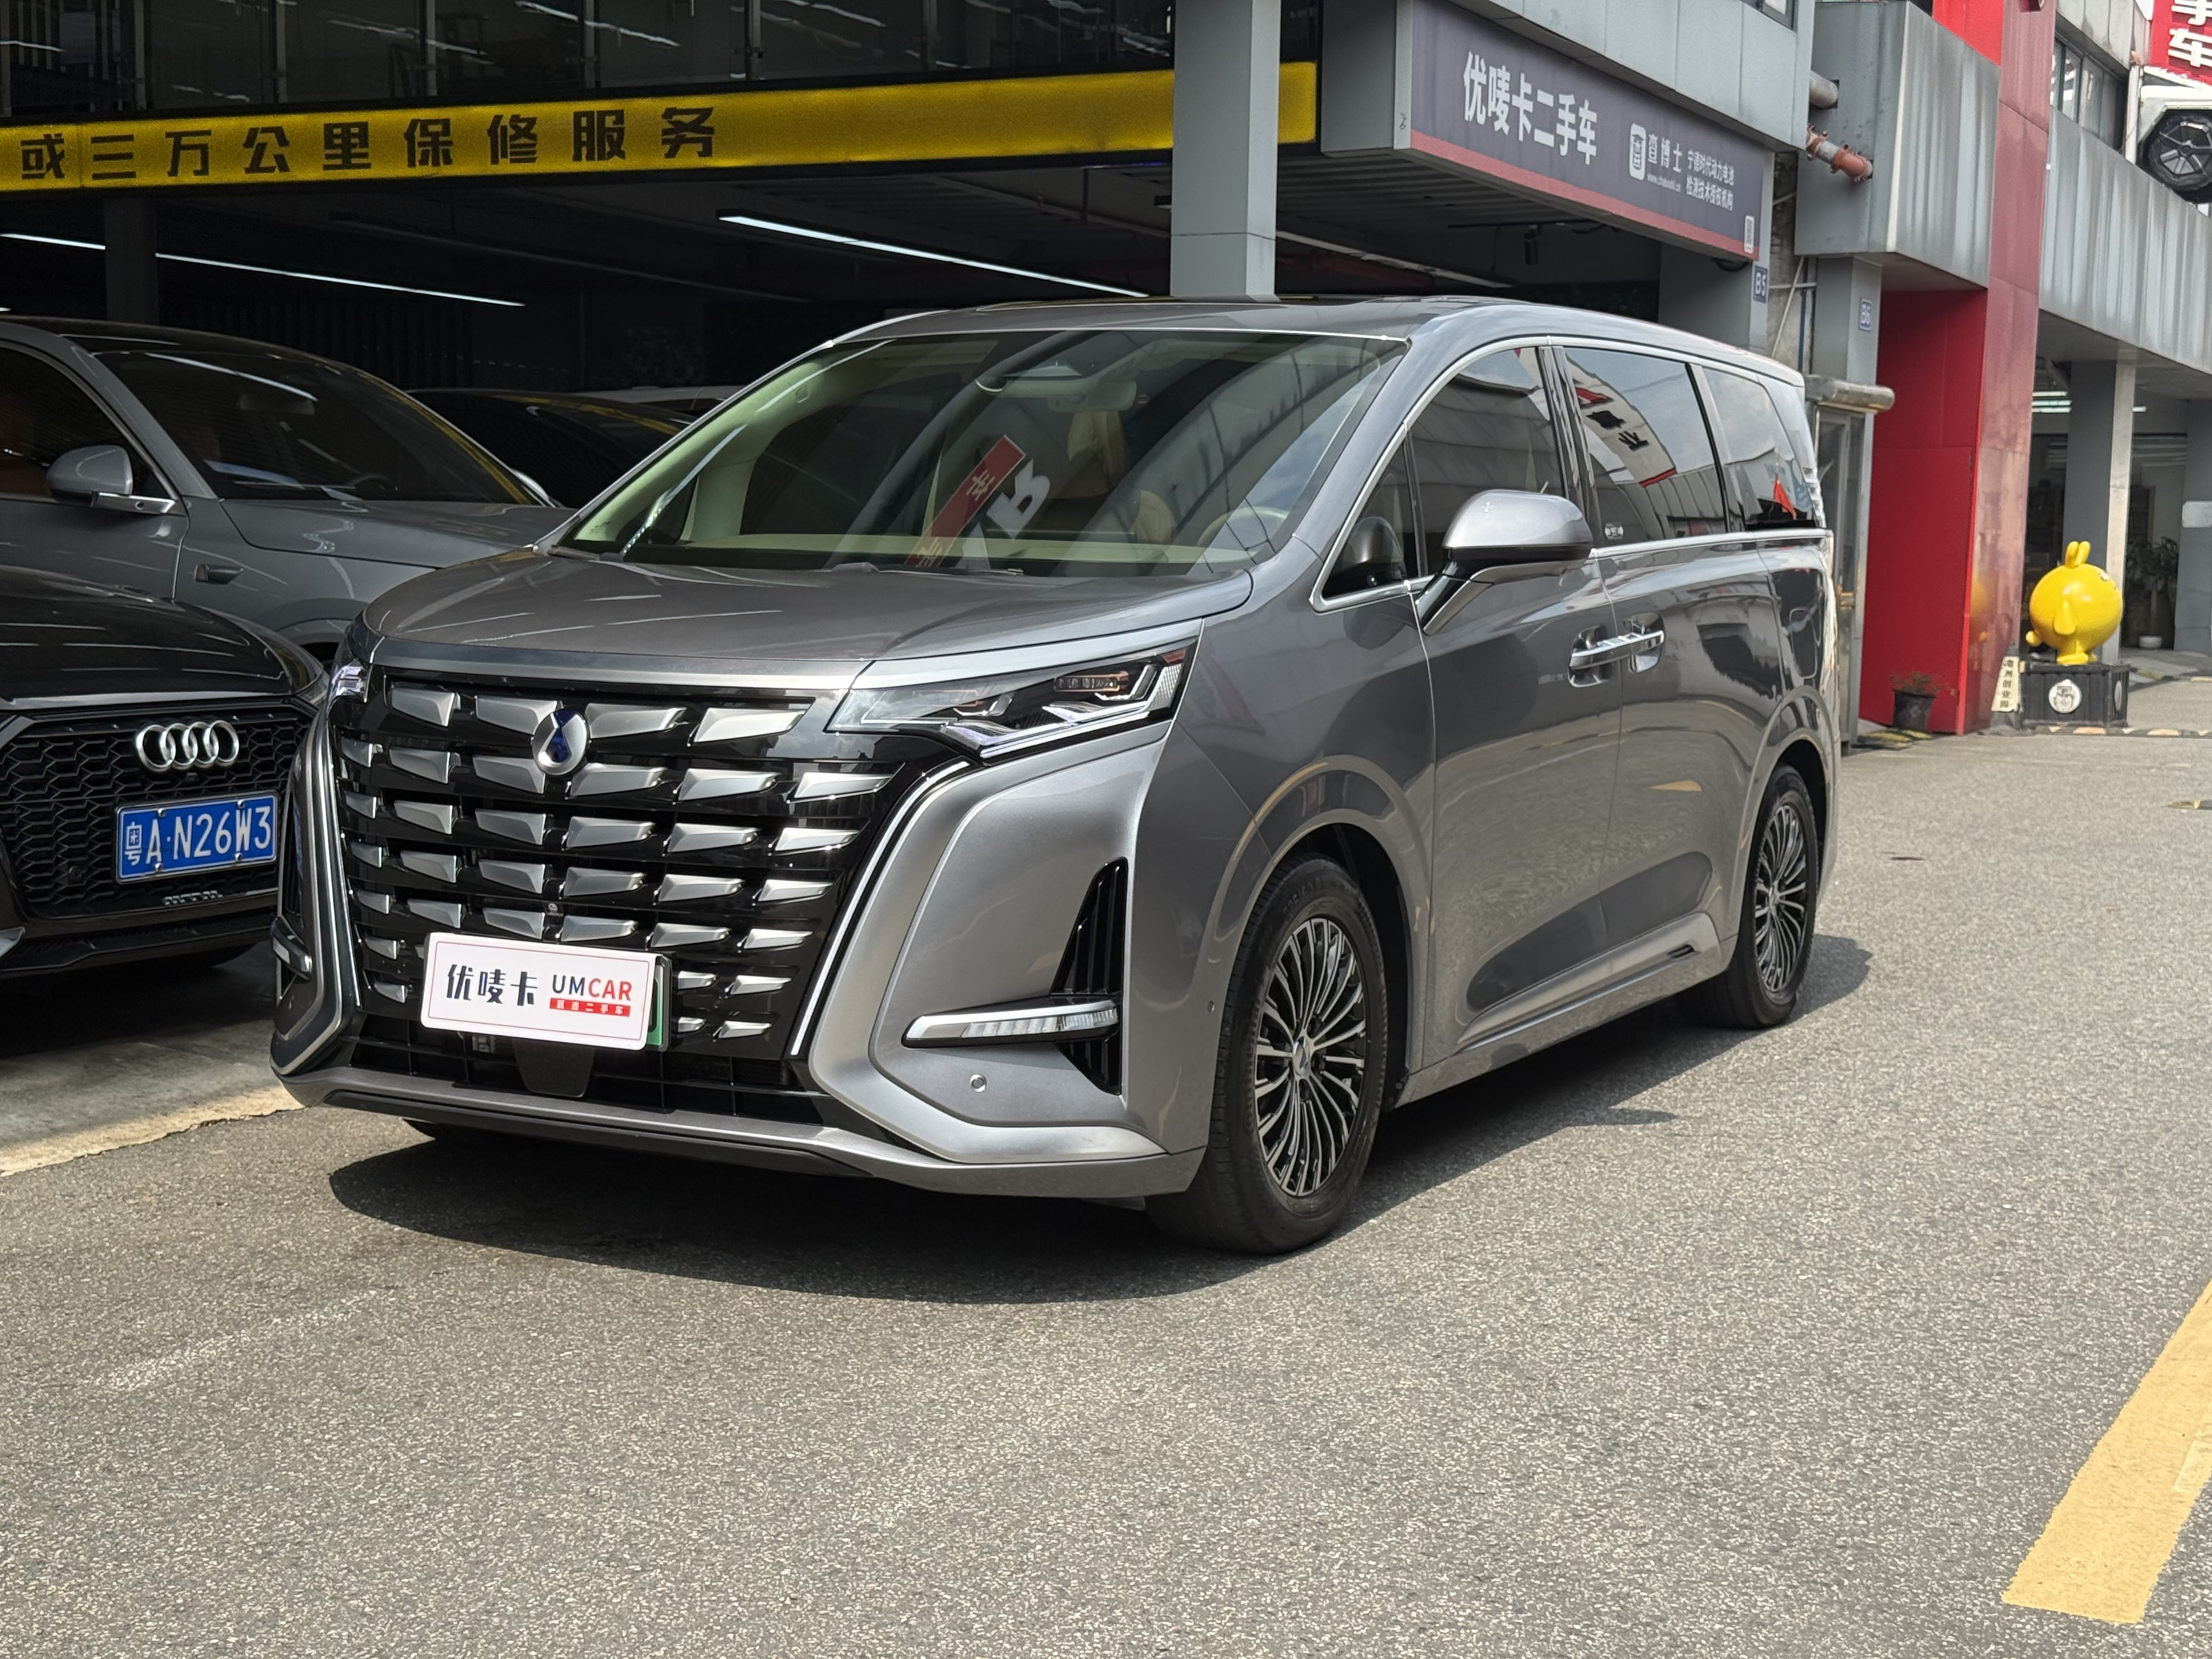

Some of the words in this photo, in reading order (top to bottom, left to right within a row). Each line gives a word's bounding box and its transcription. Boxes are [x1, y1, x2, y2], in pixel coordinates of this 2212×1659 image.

[1463, 50, 1598, 165] 优唛卡二手车
[20, 107, 715, 180] 或三万公里保修服务
[1647, 134, 1682, 173] 查博士
[1756, 272, 1766, 296] B5
[446, 964, 539, 1007] 优唛卡
[552, 974, 632, 1001] UMCAR
